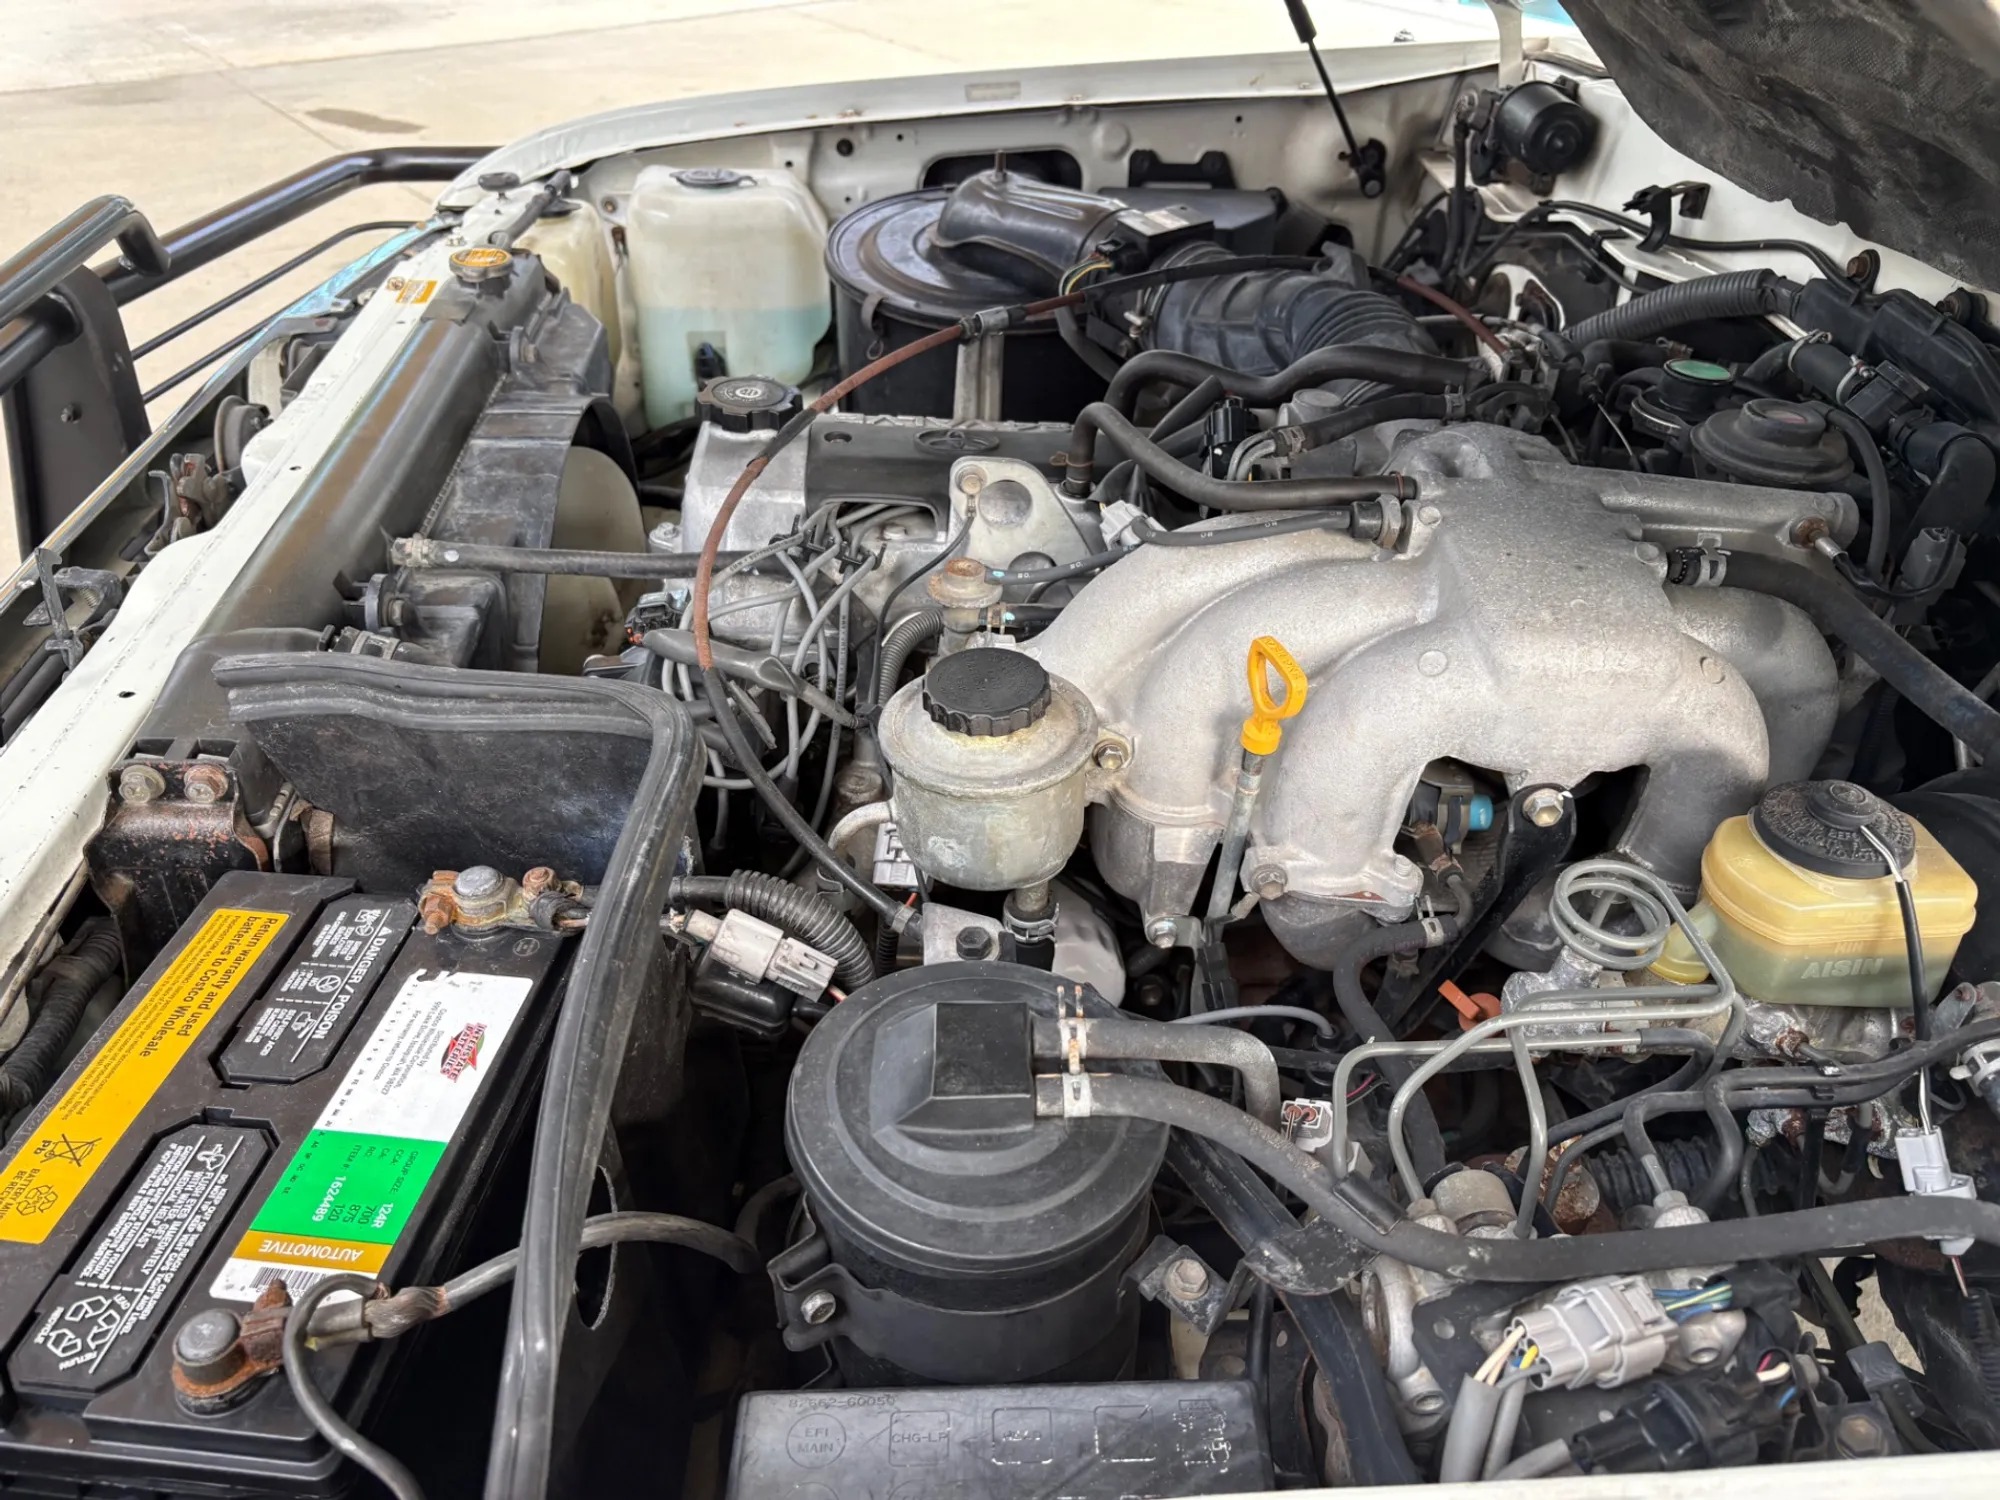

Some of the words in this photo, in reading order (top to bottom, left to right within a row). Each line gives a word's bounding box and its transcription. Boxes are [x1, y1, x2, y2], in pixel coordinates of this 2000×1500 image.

[218, 916, 261, 955] batteries
[245, 917, 279, 947] Return
[208, 949, 254, 989] warranty
[209, 957, 227, 967] to
[346, 937, 388, 983] DANGER
[1801, 957, 1884, 980] AISIN
[181, 969, 219, 1002] Costco
[340, 985, 357, 993] /
[196, 991, 221, 1009] and
[174, 1012, 205, 1036] used
[310, 994, 352, 1038] POISON
[137, 1005, 191, 1057] Wholesale
[438, 1023, 476, 1075] BATTERIES
[446, 1023, 487, 1080] INTERSTATE
[31, 1139, 53, 1154] Pb
[13, 1170, 28, 1178] BE
[399, 1150, 419, 1175] GROUP
[7, 1168, 41, 1200] BATTERY
[162, 1169, 197, 1204] MEDICAL
[182, 1170, 206, 1191] WITH
[188, 1171, 215, 1196] FLUSH
[174, 1197, 198, 1219] EYES
[309, 1175, 348, 1222] 1624489
[148, 1204, 173, 1226] HELP
[326, 1203, 345, 1221] 120
[341, 1204, 361, 1223] 875
[356, 1205, 377, 1224] 700
[369, 1202, 395, 1228] 124R
[133, 1227, 157, 1248] FAST
[150, 1223, 170, 1240] GET
[136, 1220, 184, 1274] IMMEDIATELY
[258, 1239, 364, 1262] AUTOMOTIVE
[112, 1293, 131, 1310] LEAD
[30, 1305, 67, 1345] RECYCLE
[804, 1427, 829, 1438] EFI
[892, 1433, 948, 1444] CHG-LP
[797, 1442, 834, 1453] MAIN
